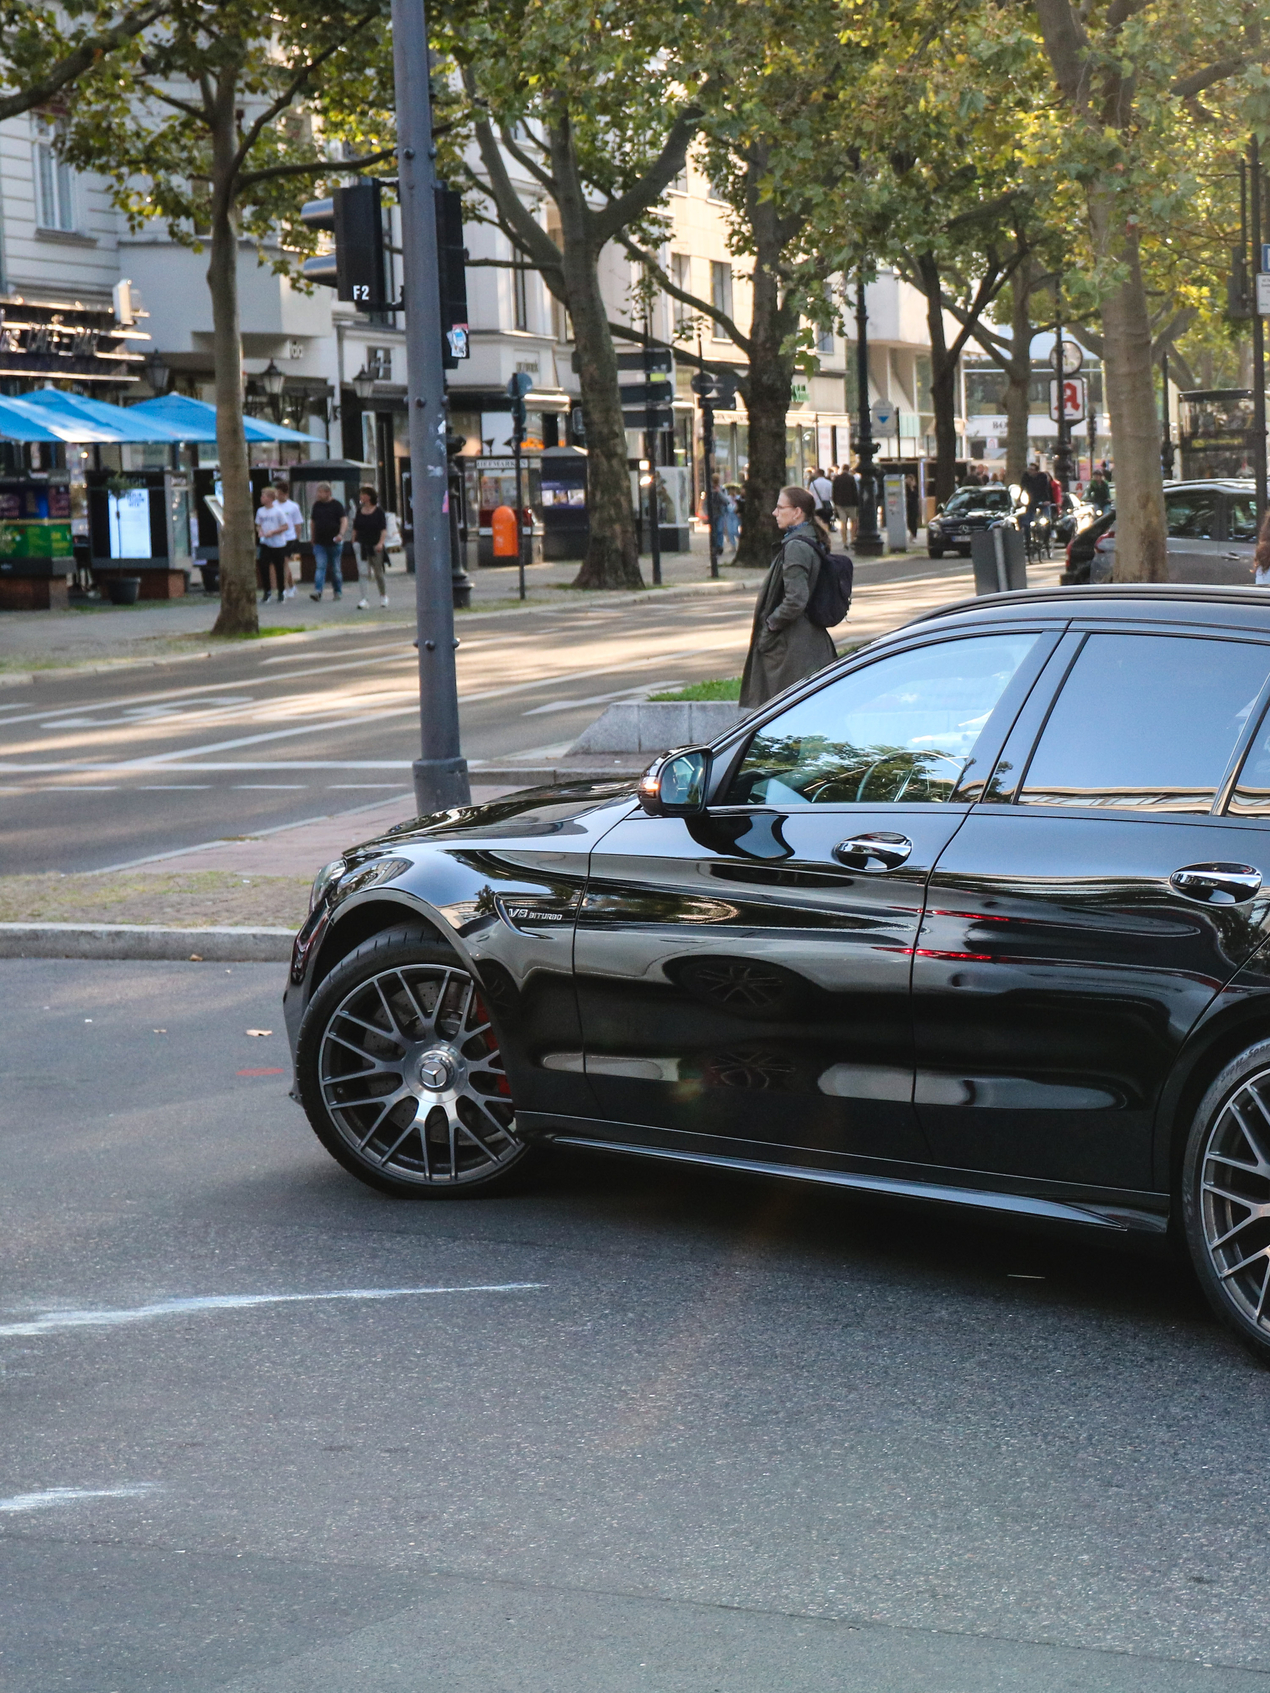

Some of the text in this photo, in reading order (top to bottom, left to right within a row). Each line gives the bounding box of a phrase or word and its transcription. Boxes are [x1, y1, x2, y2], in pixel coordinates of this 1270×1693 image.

[352, 285, 370, 301] F2
[508, 908, 563, 920] V8 BITURBO
